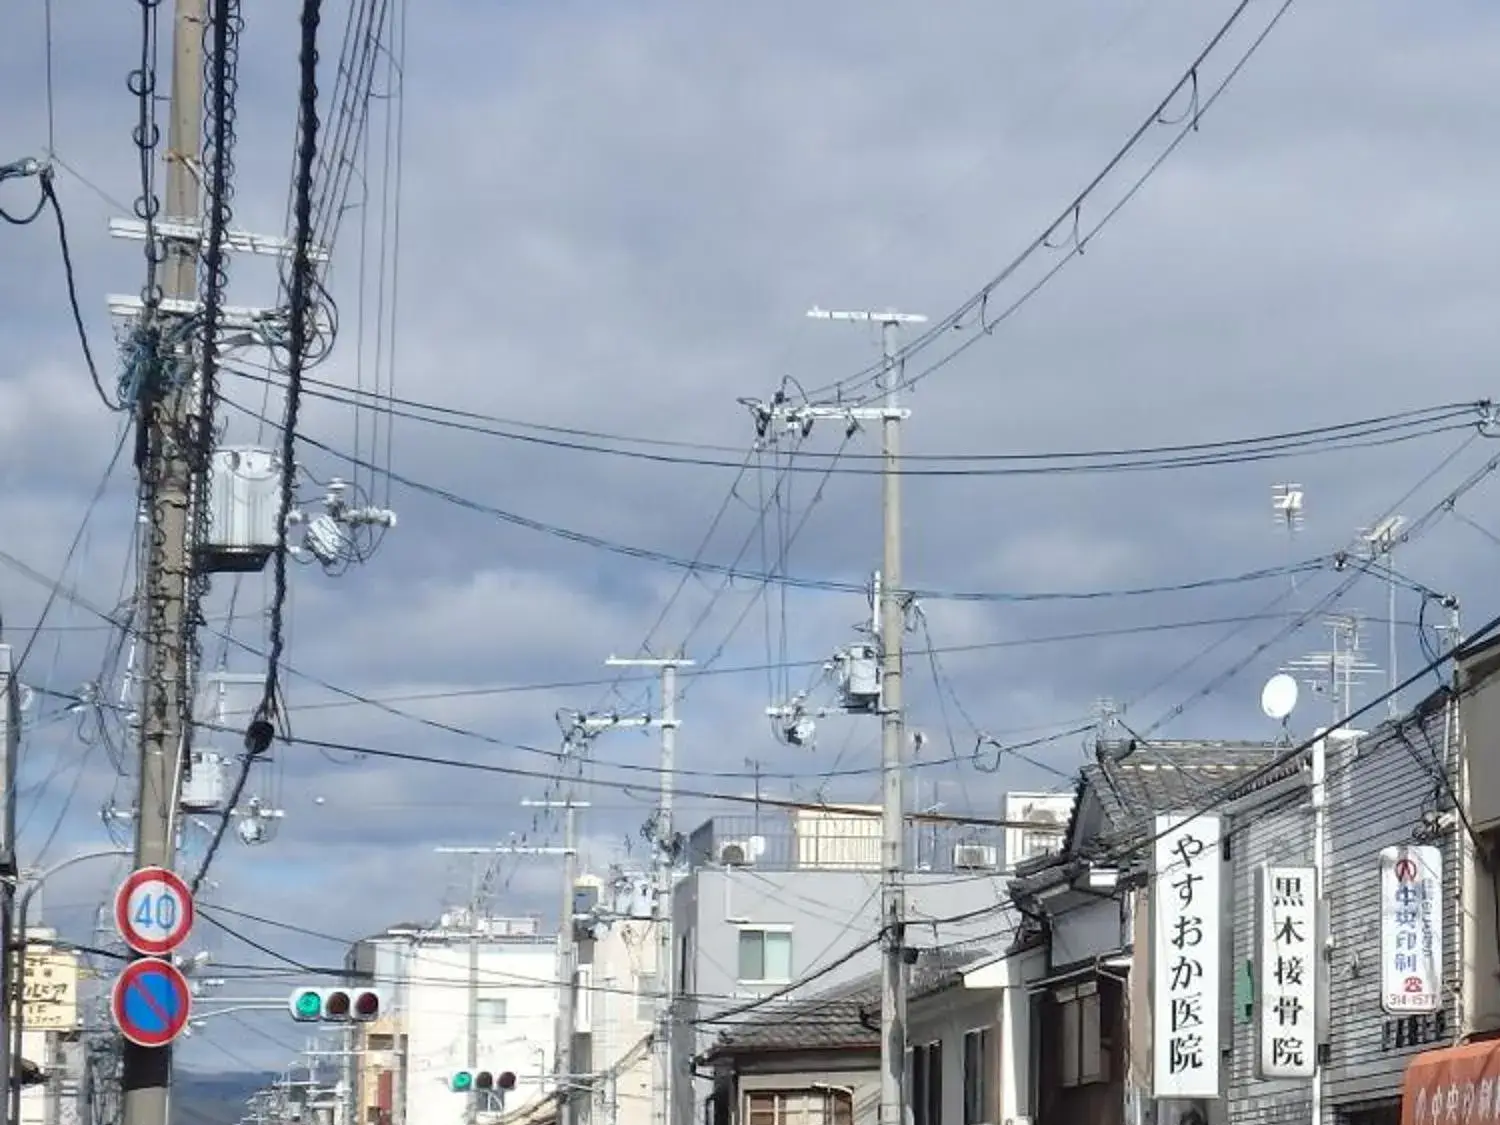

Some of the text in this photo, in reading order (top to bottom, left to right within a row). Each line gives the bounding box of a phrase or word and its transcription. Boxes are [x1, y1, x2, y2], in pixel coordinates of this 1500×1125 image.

[134, 893, 176, 930] 40
[1169, 834, 1204, 1075] やすおか医院
[1273, 877, 1304, 1066] 黒木接骨院
